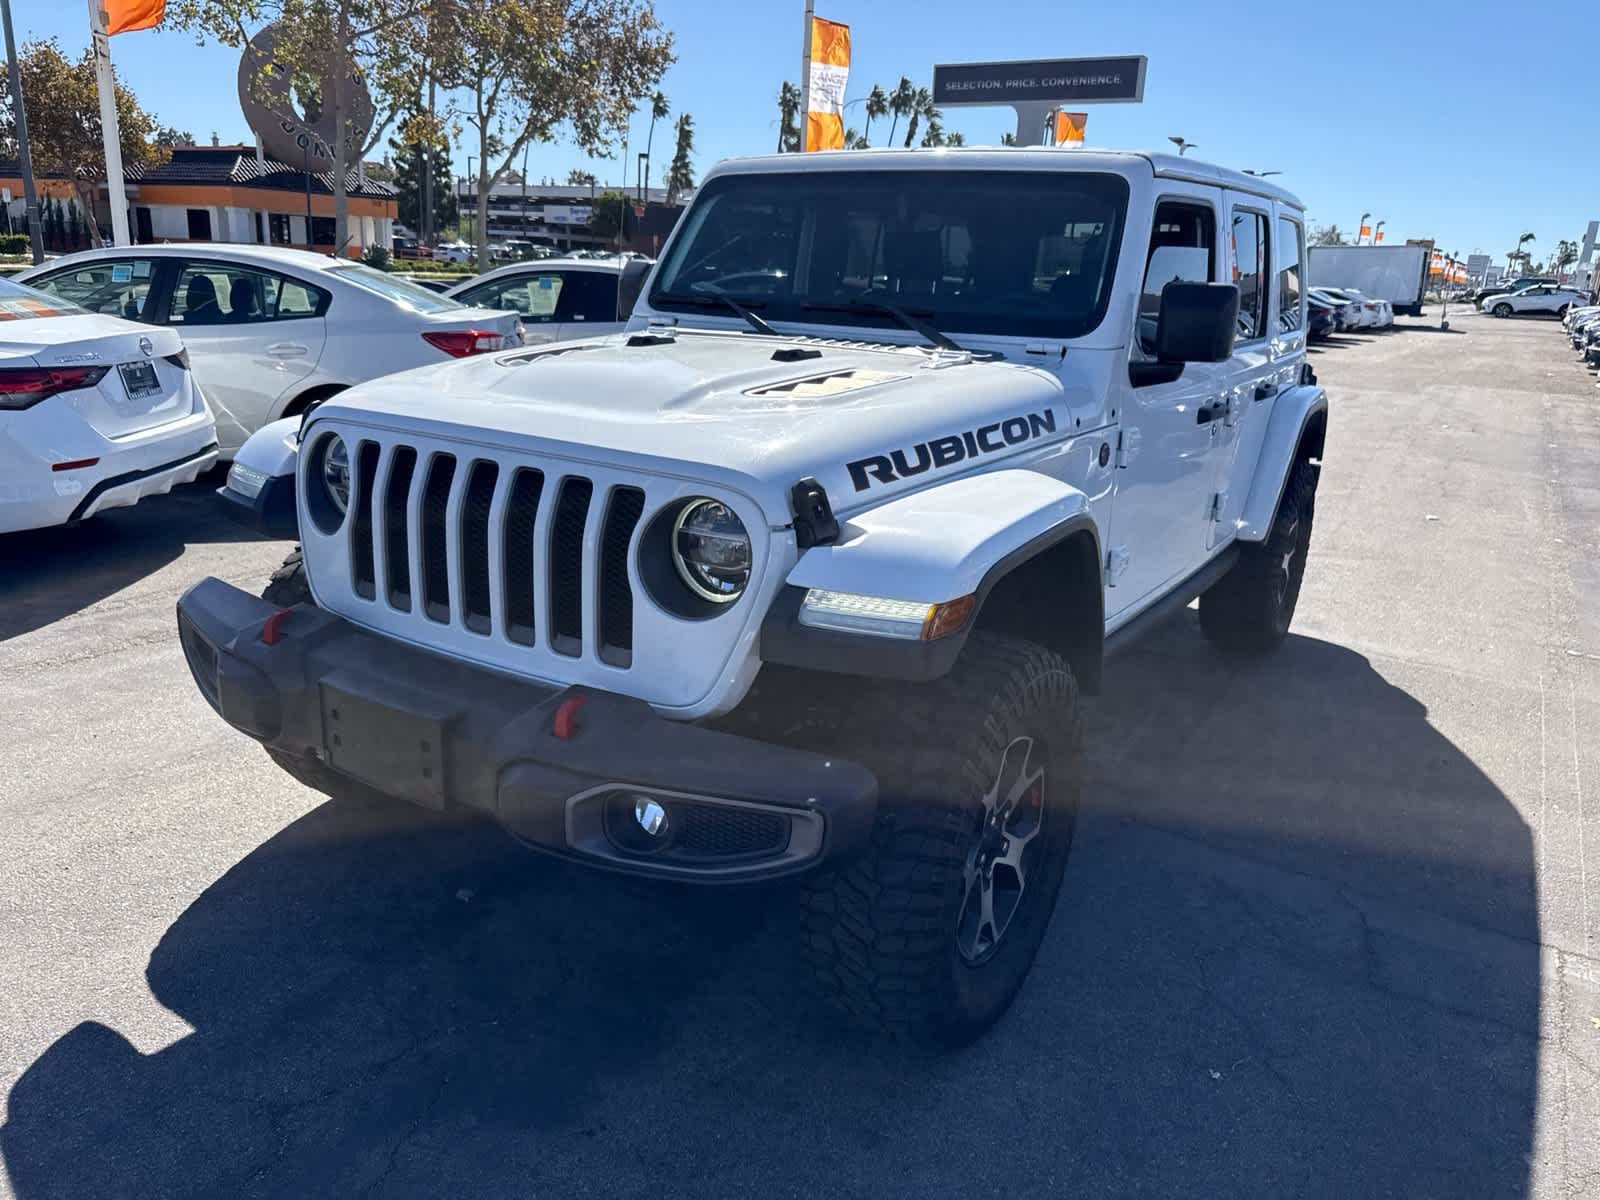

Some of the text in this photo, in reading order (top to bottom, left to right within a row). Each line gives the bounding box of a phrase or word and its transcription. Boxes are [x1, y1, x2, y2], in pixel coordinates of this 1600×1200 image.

[945, 80, 1003, 91] SELECTION.
[1005, 78, 1039, 89] PRICE.
[847, 408, 1057, 492] RUBICON
